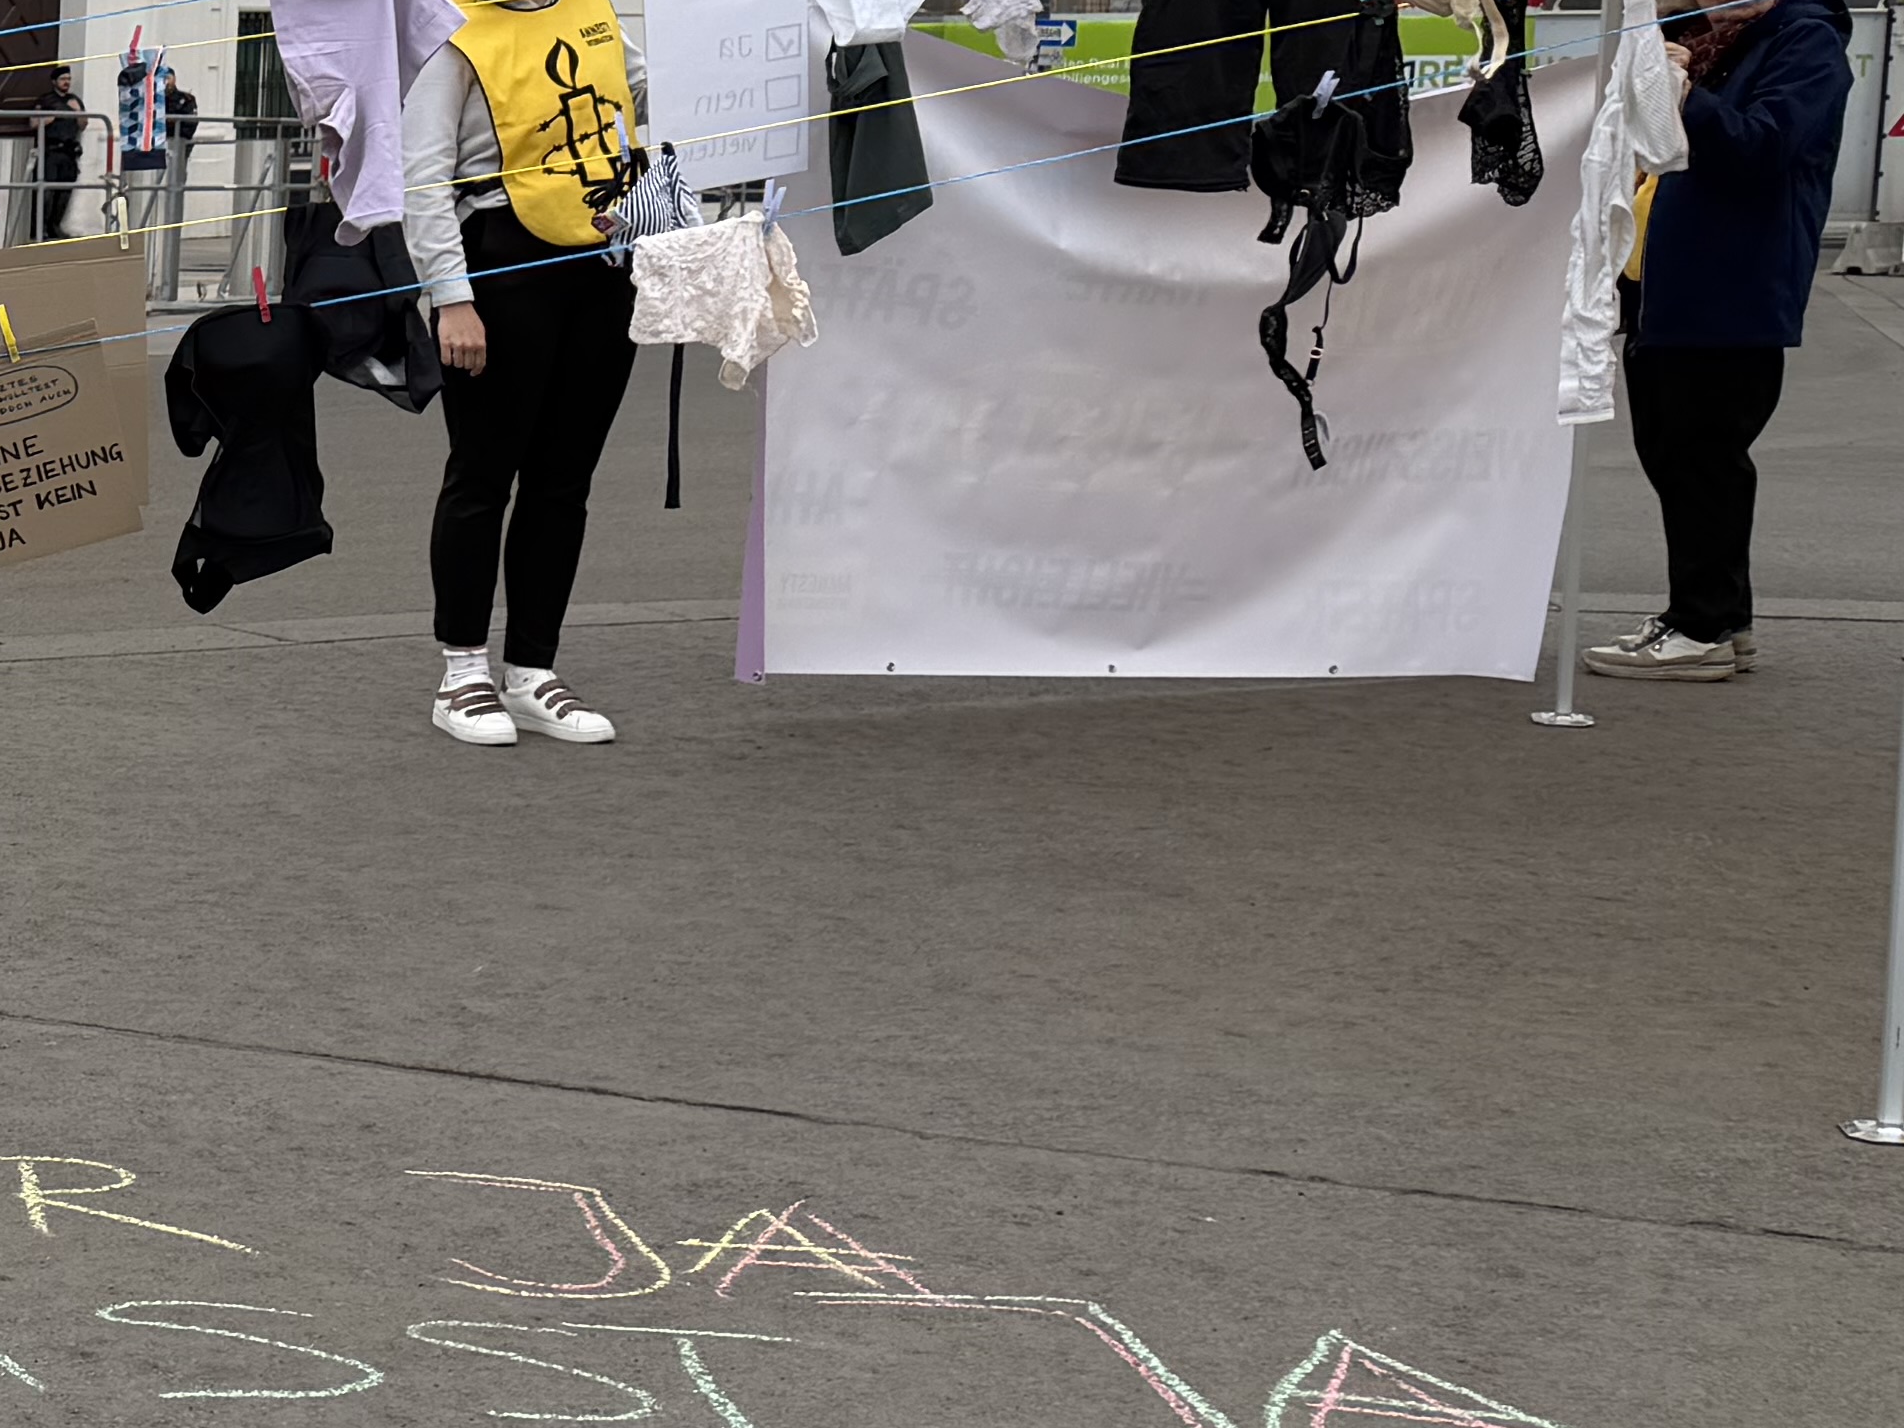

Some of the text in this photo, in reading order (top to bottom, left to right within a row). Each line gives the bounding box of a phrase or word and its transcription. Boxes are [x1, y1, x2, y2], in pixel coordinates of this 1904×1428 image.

[0, 400, 33, 416] DOCH
[39, 388, 72, 404] AUCH
[35, 479, 98, 510] KEIN
[400, 1164, 925, 1302] JA
